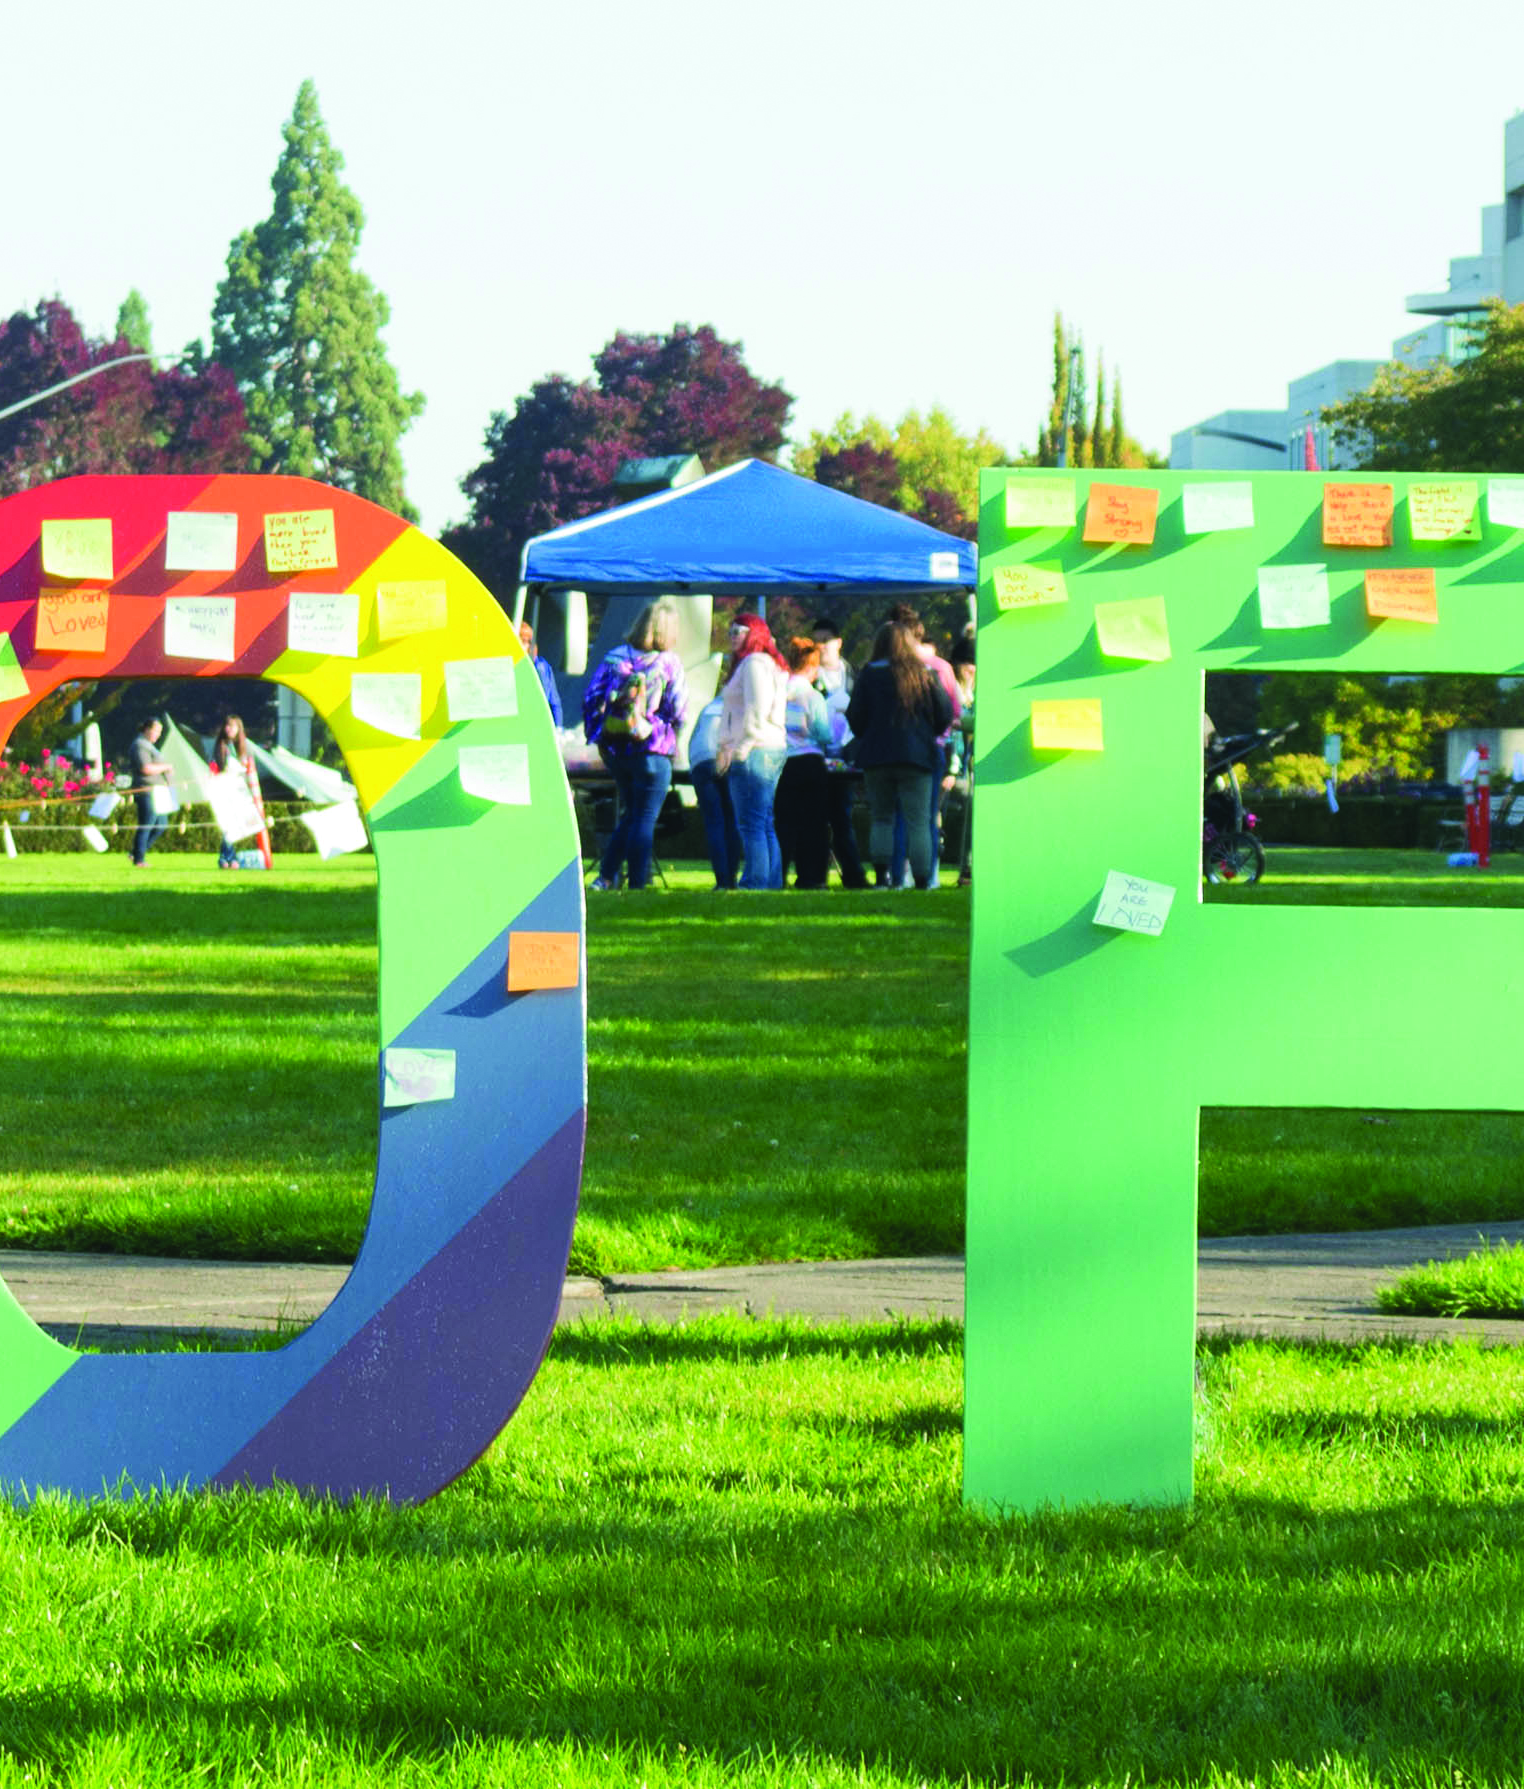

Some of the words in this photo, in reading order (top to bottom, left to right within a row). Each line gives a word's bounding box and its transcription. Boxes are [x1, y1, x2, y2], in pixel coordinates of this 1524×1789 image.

[47, 612, 107, 637] Loved
[1124, 879, 1148, 894] YOU
[1120, 893, 1148, 906] ARE
[1095, 903, 1163, 929] LOVED
